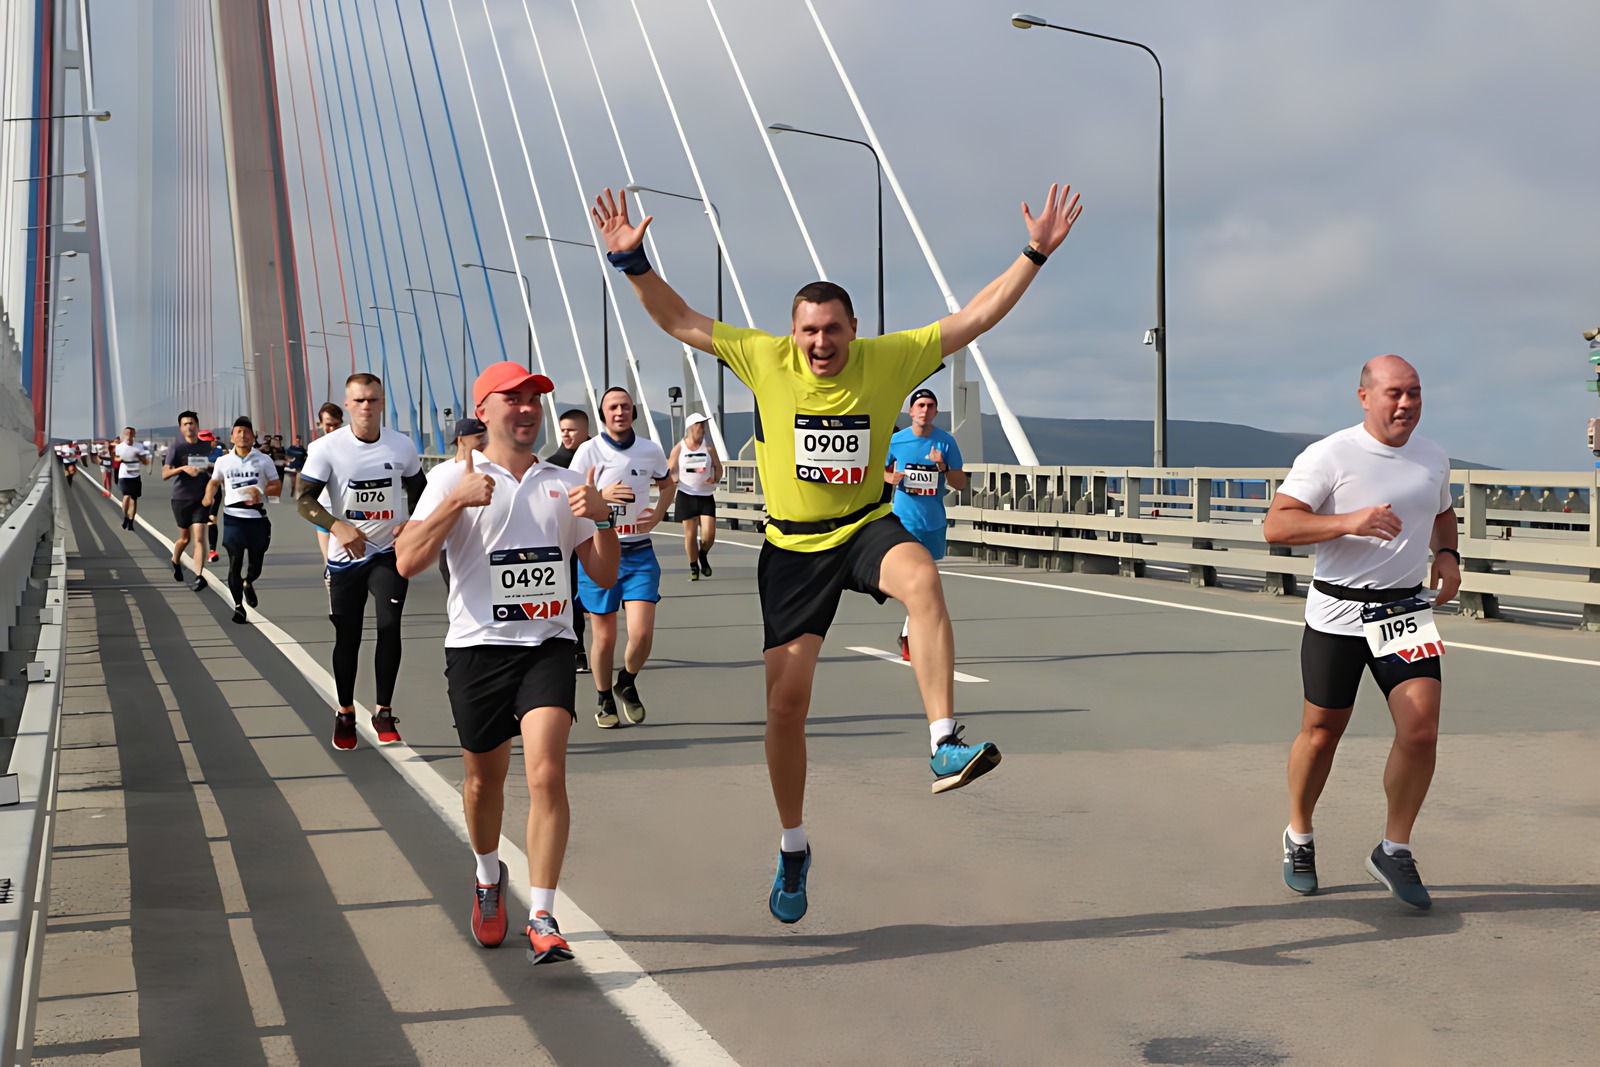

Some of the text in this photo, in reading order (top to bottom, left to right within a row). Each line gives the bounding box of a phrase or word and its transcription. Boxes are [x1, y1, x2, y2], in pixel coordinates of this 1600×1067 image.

[804, 434, 859, 453] 0908
[355, 490, 386, 503] 1076
[501, 566, 556, 589] 0492
[1379, 616, 1418, 642] 1195
